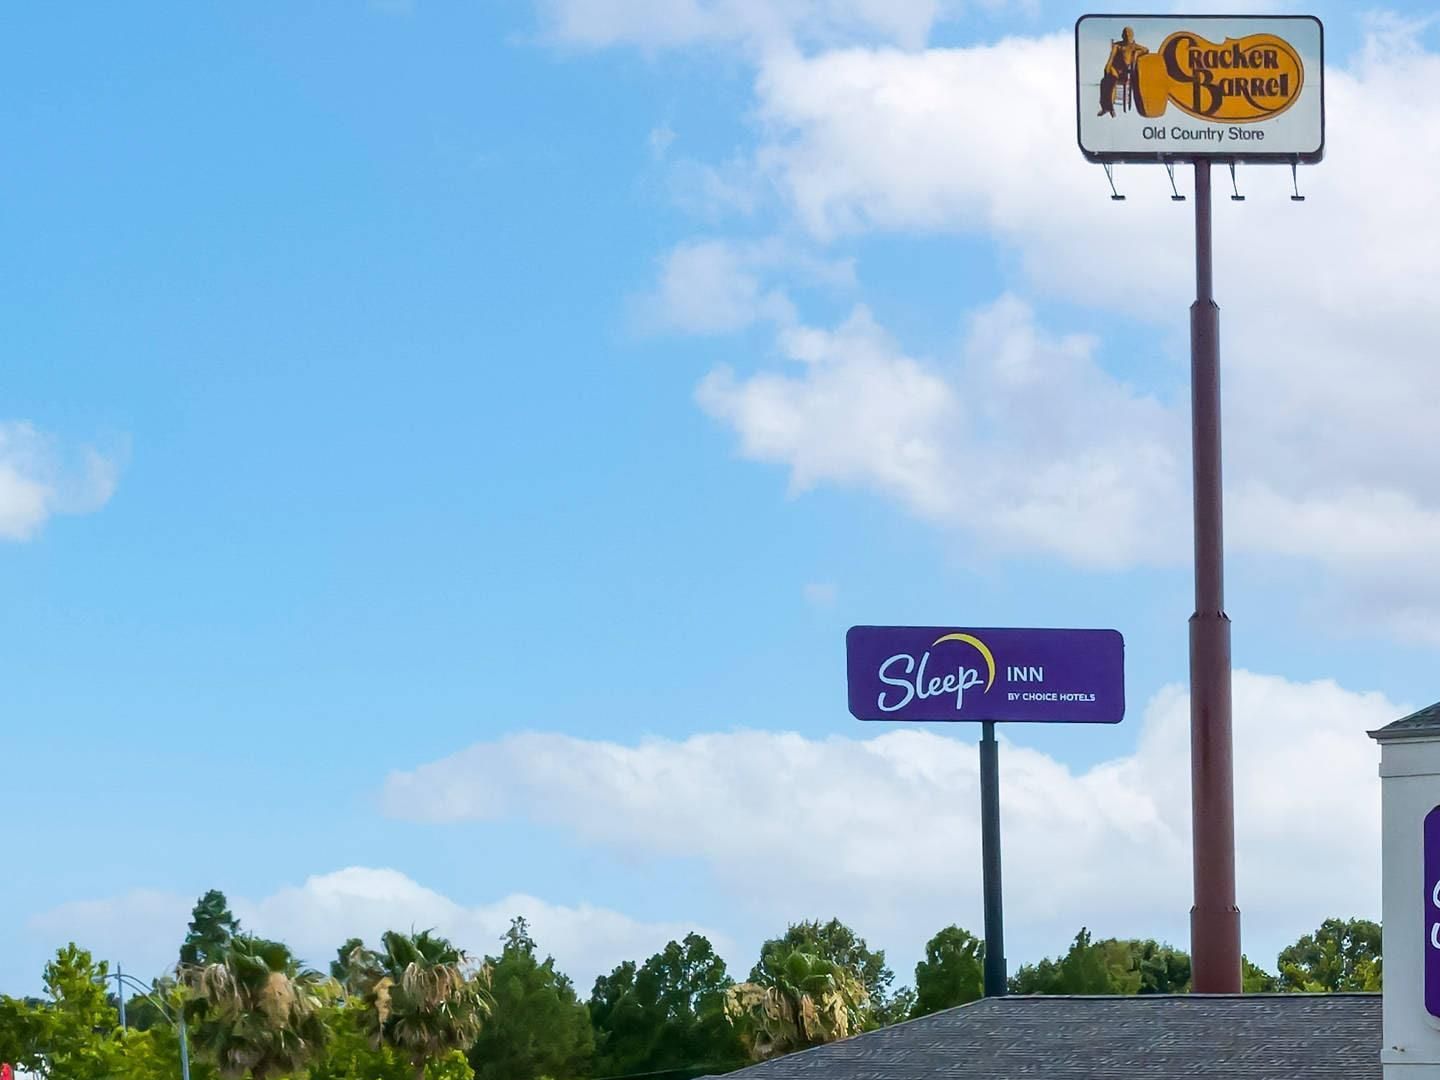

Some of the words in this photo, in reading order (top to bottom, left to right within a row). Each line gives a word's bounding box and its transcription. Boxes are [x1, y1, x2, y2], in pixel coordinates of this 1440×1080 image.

[1163, 36, 1279, 82] Cracker
[1192, 69, 1289, 116] Barrel
[1142, 126, 1166, 140] Old
[1171, 126, 1224, 142] Country
[1228, 126, 1265, 140] Store
[877, 651, 984, 712] Sleep
[1007, 666, 1044, 682] INN
[1007, 692, 1020, 701] BY
[1022, 692, 1058, 702] CHOICE
[1059, 693, 1096, 702] HOTELS
